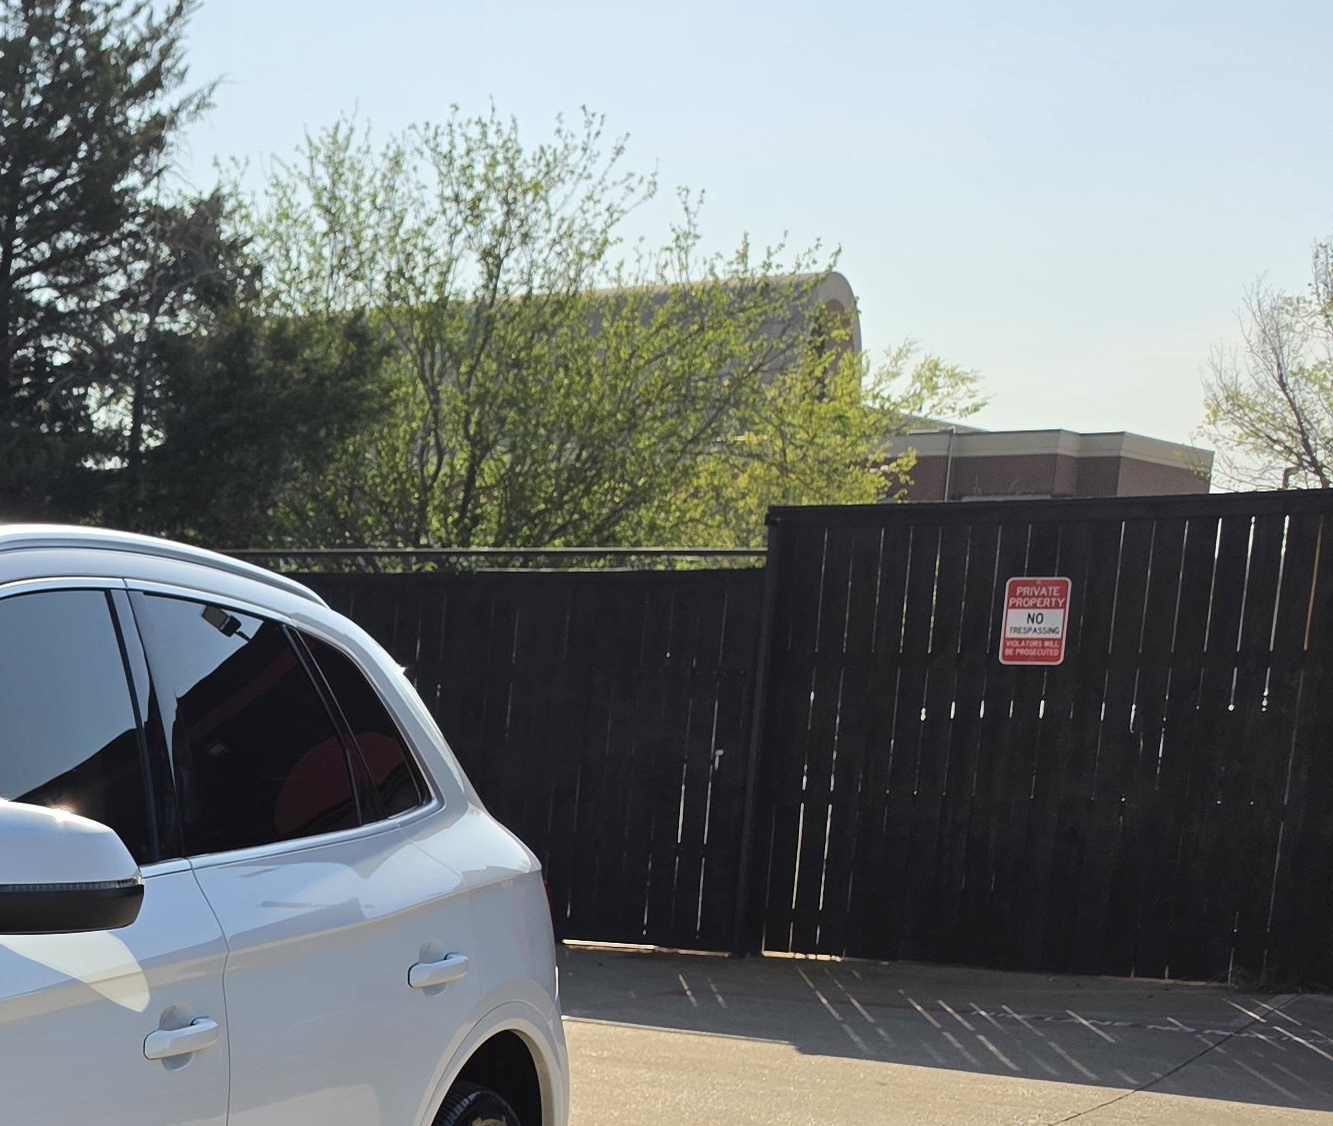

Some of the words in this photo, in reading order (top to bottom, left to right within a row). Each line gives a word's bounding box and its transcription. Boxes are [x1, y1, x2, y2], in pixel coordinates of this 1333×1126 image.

[1016, 586, 1061, 597] PRIVATE
[1008, 597, 1066, 608] PROPERTY
[1026, 612, 1044, 625] NO
[1009, 626, 1060, 635] TRESPASSING
[1006, 640, 1043, 648] VIOLATORS
[1044, 640, 1060, 648] WILL
[1005, 648, 1014, 656] BE
[1015, 648, 1059, 656] PROSECUTED
